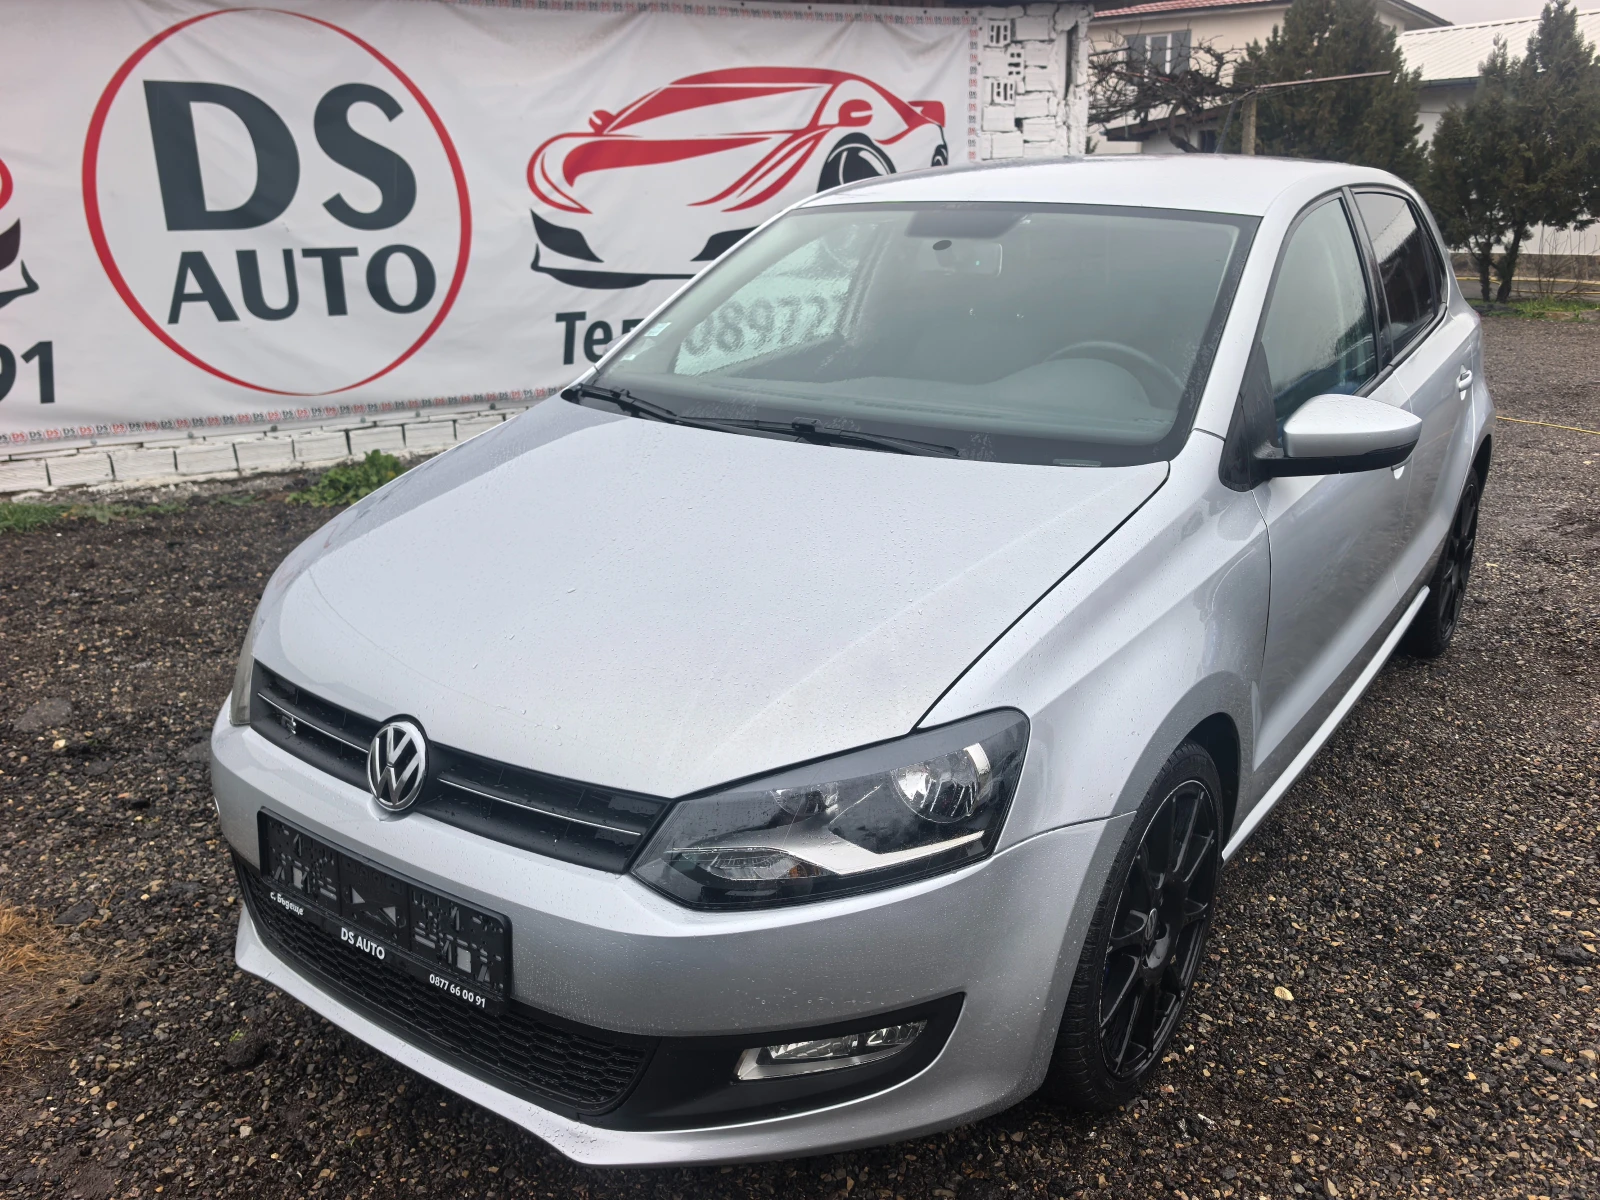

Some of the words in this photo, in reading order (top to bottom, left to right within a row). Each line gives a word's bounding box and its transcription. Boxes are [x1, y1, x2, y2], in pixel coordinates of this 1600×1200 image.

[143, 80, 417, 231] DS
[167, 244, 437, 325] AUTO
[277, 892, 304, 916] Бъдеще
[341, 927, 355, 945] DS
[355, 935, 386, 960] AUTO
[429, 974, 449, 991] 0877
[450, 984, 460, 996] 66
[462, 989, 474, 1003] 00
[475, 996, 486, 1008] 91
